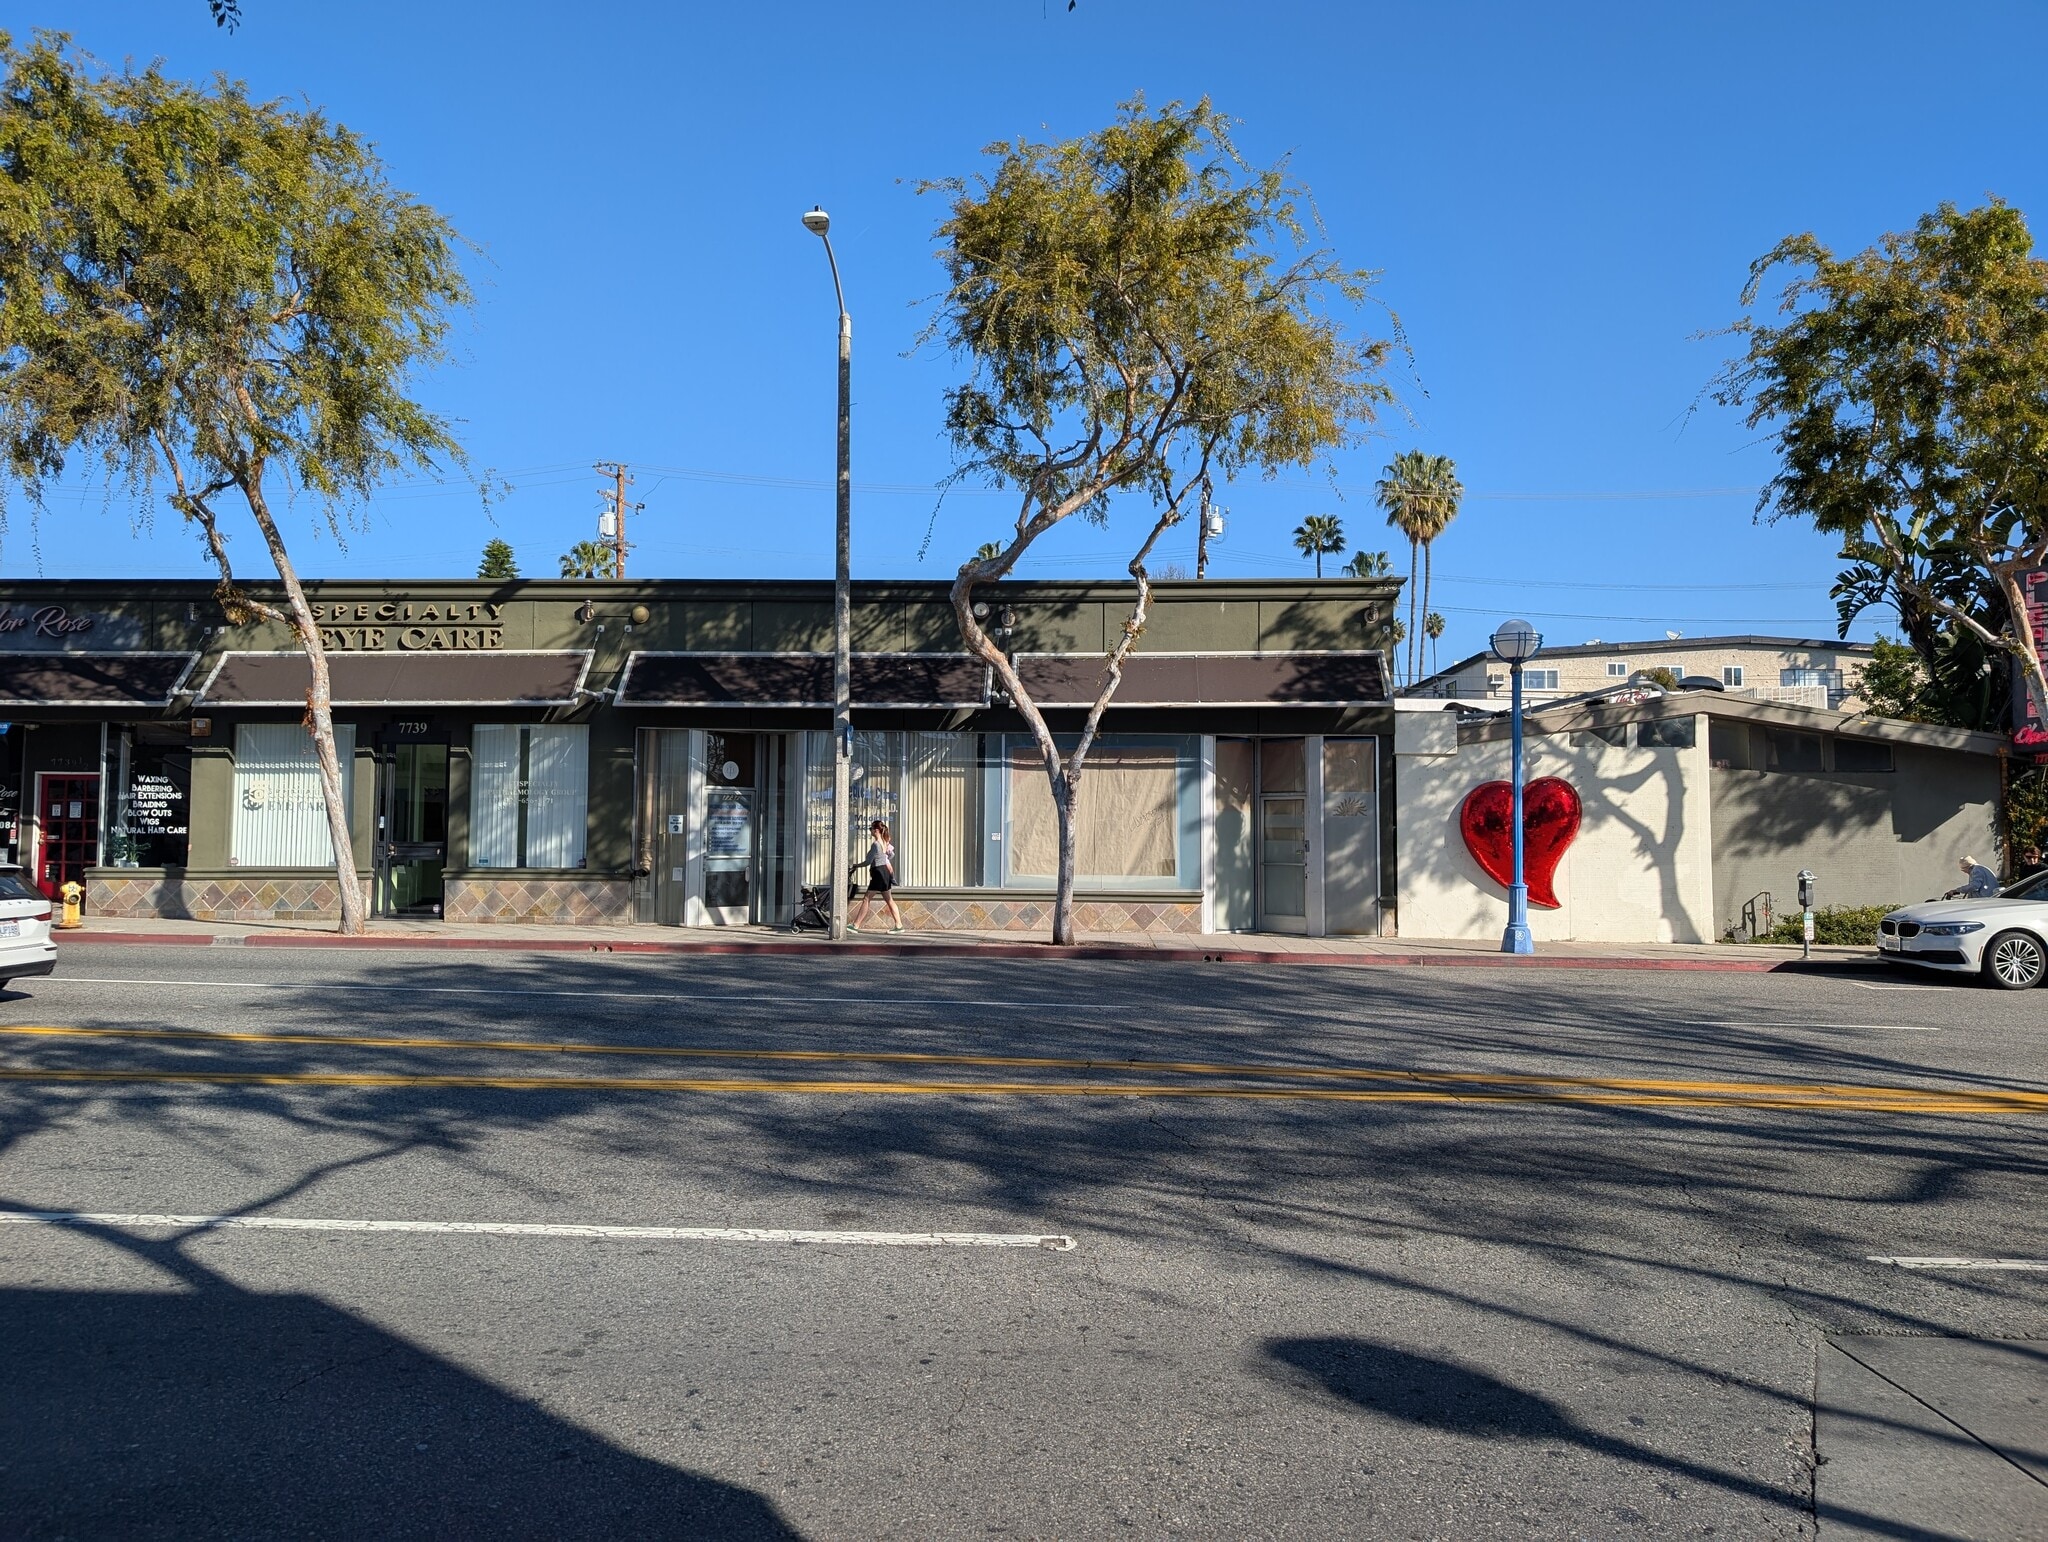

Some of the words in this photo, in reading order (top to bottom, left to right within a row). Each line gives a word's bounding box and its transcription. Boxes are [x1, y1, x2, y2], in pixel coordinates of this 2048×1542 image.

[312, 604, 505, 618] SPECIALTY
[32, 605, 92, 637] Rose
[319, 627, 387, 650] EYE
[400, 627, 505, 650] CARE
[399, 722, 427, 734] 7739
[137, 774, 168, 783] WAXING
[131, 784, 173, 792] BARBERING
[118, 792, 136, 800] HAIR
[138, 792, 182, 800] EXTENSIONS
[299, 801, 326, 812] CAR
[128, 809, 150, 817] BLOW
[151, 809, 172, 817] OUTS
[140, 818, 160, 826] WIGS
[110, 826, 146, 834] NATURAL
[148, 826, 165, 834] HAIR
[166, 826, 188, 834] CARE
